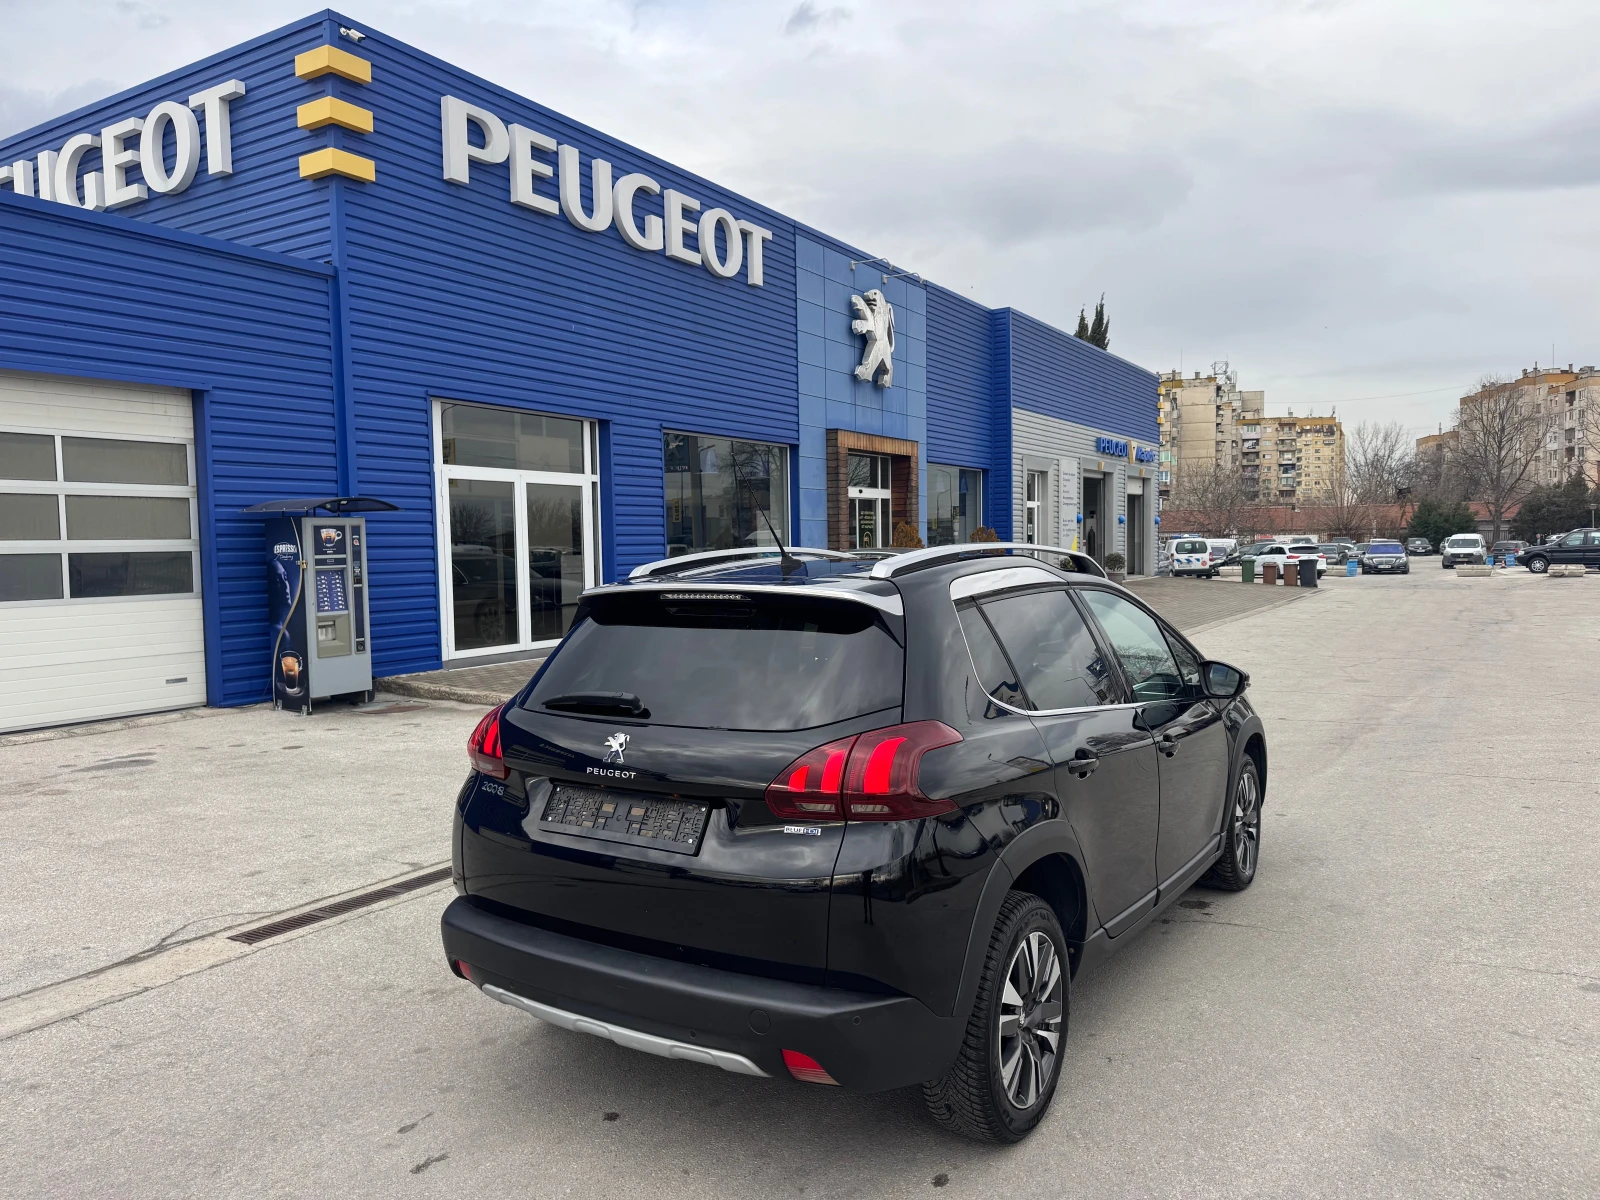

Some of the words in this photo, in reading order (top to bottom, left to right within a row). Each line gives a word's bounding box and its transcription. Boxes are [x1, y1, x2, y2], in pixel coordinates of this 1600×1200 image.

[0, 78, 246, 212] UGEOT
[440, 94, 773, 287] PEUGEOT
[482, 781, 505, 796] 2008
[586, 767, 637, 780] PEUGEOT
